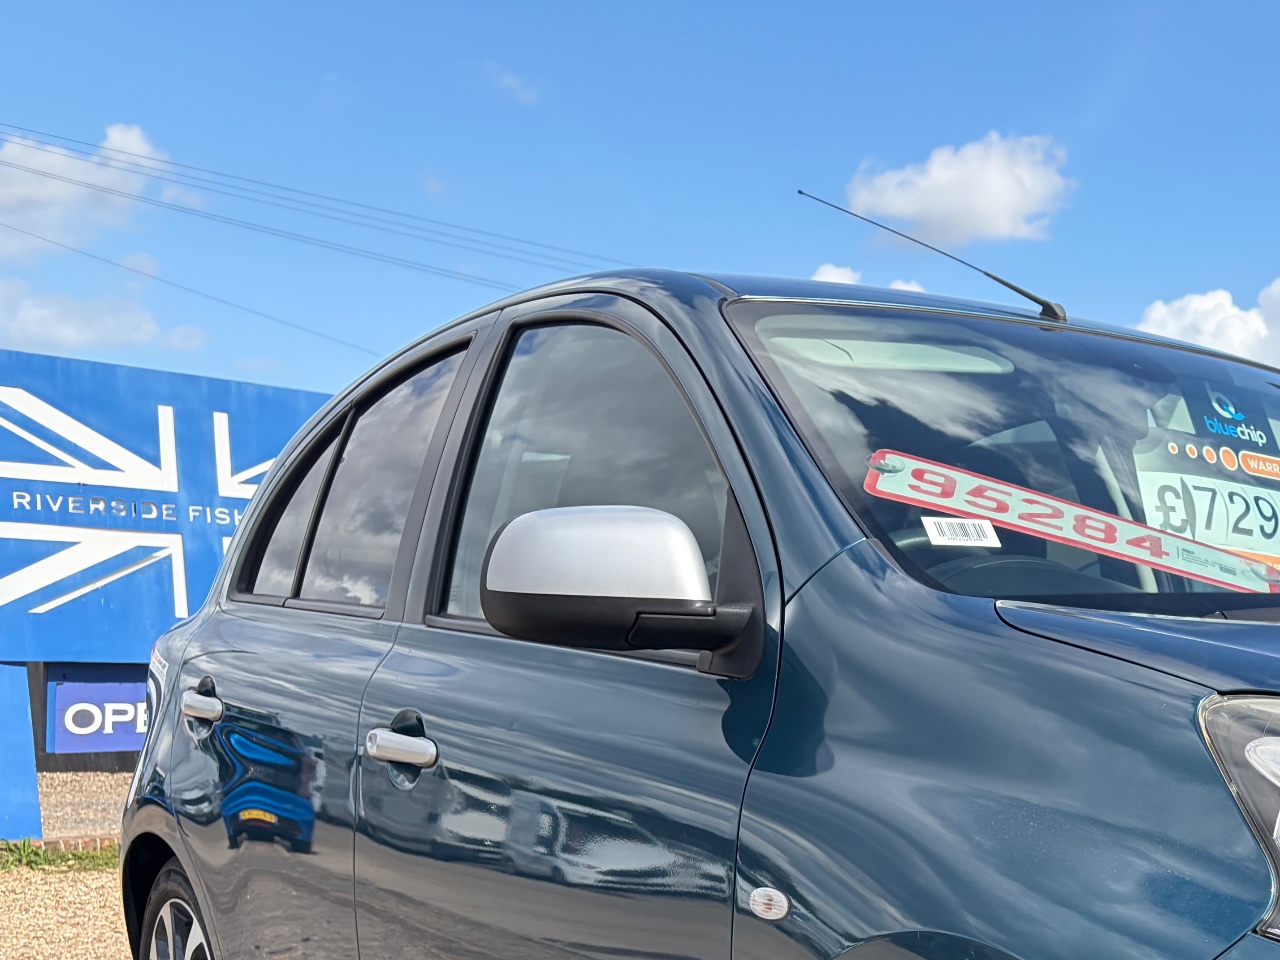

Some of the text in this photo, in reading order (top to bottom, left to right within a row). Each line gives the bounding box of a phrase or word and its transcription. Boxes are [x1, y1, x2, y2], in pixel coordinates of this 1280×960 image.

[1204, 415, 1267, 447] bluechip
[12, 491, 178, 522] RIVERSIDE
[907, 467, 1170, 559] 95284
